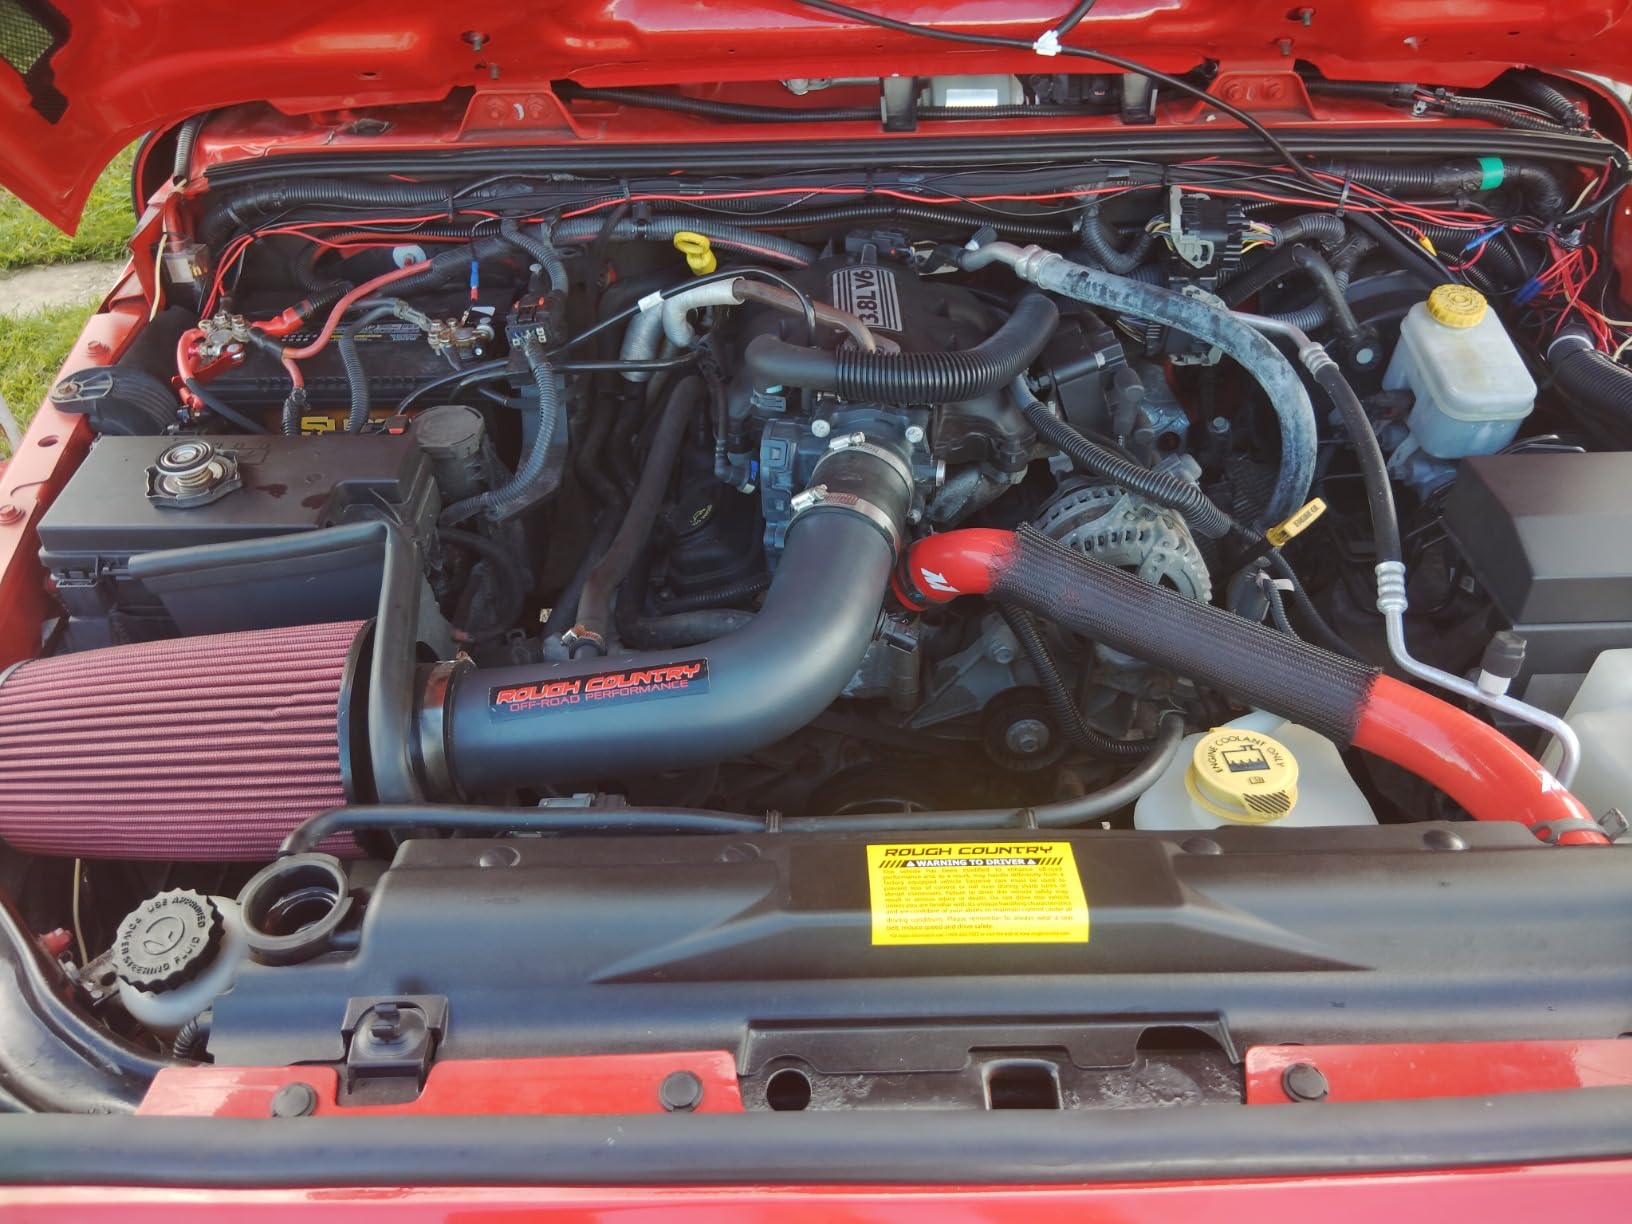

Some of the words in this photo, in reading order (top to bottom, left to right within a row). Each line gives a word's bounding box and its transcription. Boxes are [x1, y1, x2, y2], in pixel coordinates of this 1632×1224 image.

[853, 270, 875, 289] V6
[857, 291, 879, 324] 3.8L
[496, 680, 581, 705] ROUGH
[585, 663, 700, 692] COUNTRY
[509, 694, 580, 712] OFF-ROAD
[584, 679, 689, 701] PERFORMANCE
[1207, 745, 1223, 773] ENGINE
[1215, 735, 1266, 747] COOLANT
[1266, 746, 1286, 768] ONLY
[885, 848, 952, 856] ROUGH
[958, 846, 1053, 855] COUNTRY
[916, 859, 967, 867] WARNING
[968, 858, 984, 866] TO
[147, 898, 168, 913] USE
[171, 896, 206, 928] APPROVED
[121, 917, 142, 955] POWER
[173, 936, 200, 965] FLUID
[122, 955, 170, 975] STEERING
